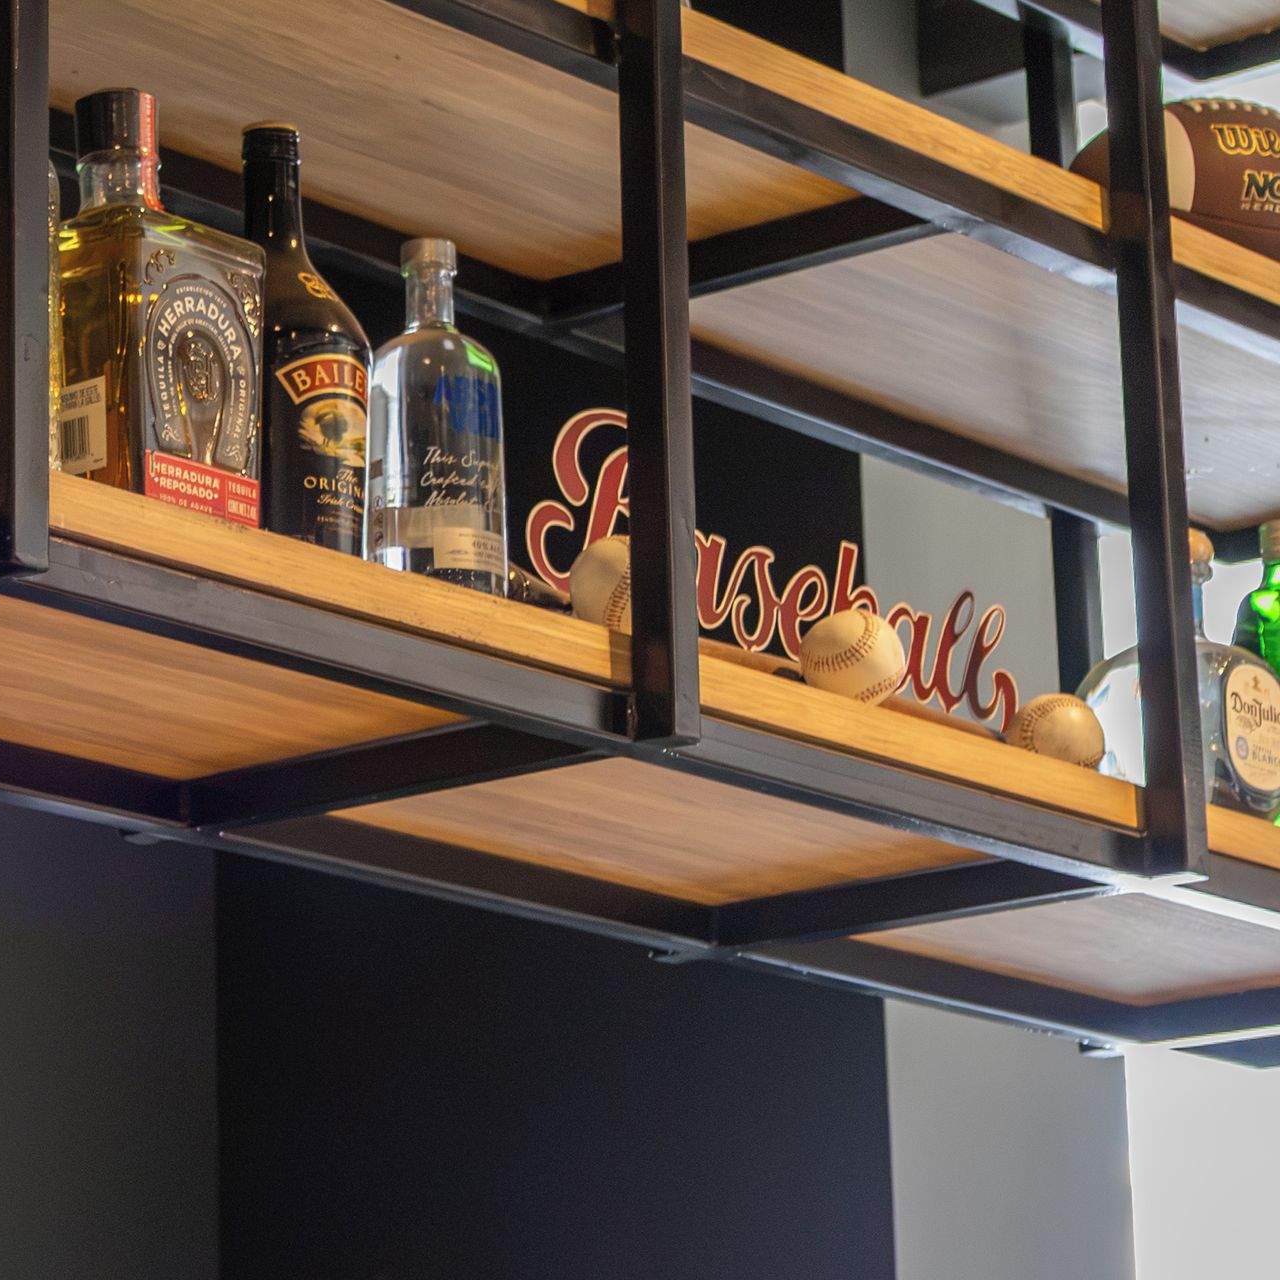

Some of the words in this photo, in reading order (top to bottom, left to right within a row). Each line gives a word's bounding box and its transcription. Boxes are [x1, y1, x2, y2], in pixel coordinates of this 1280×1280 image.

[157, 295, 243, 361] HERRADURA
[156, 355, 172, 420] TEQUILA
[153, 461, 221, 490] HERRADURA
[159, 476, 214, 501] REPOSADO
[228, 480, 258, 500] TEQUILA
